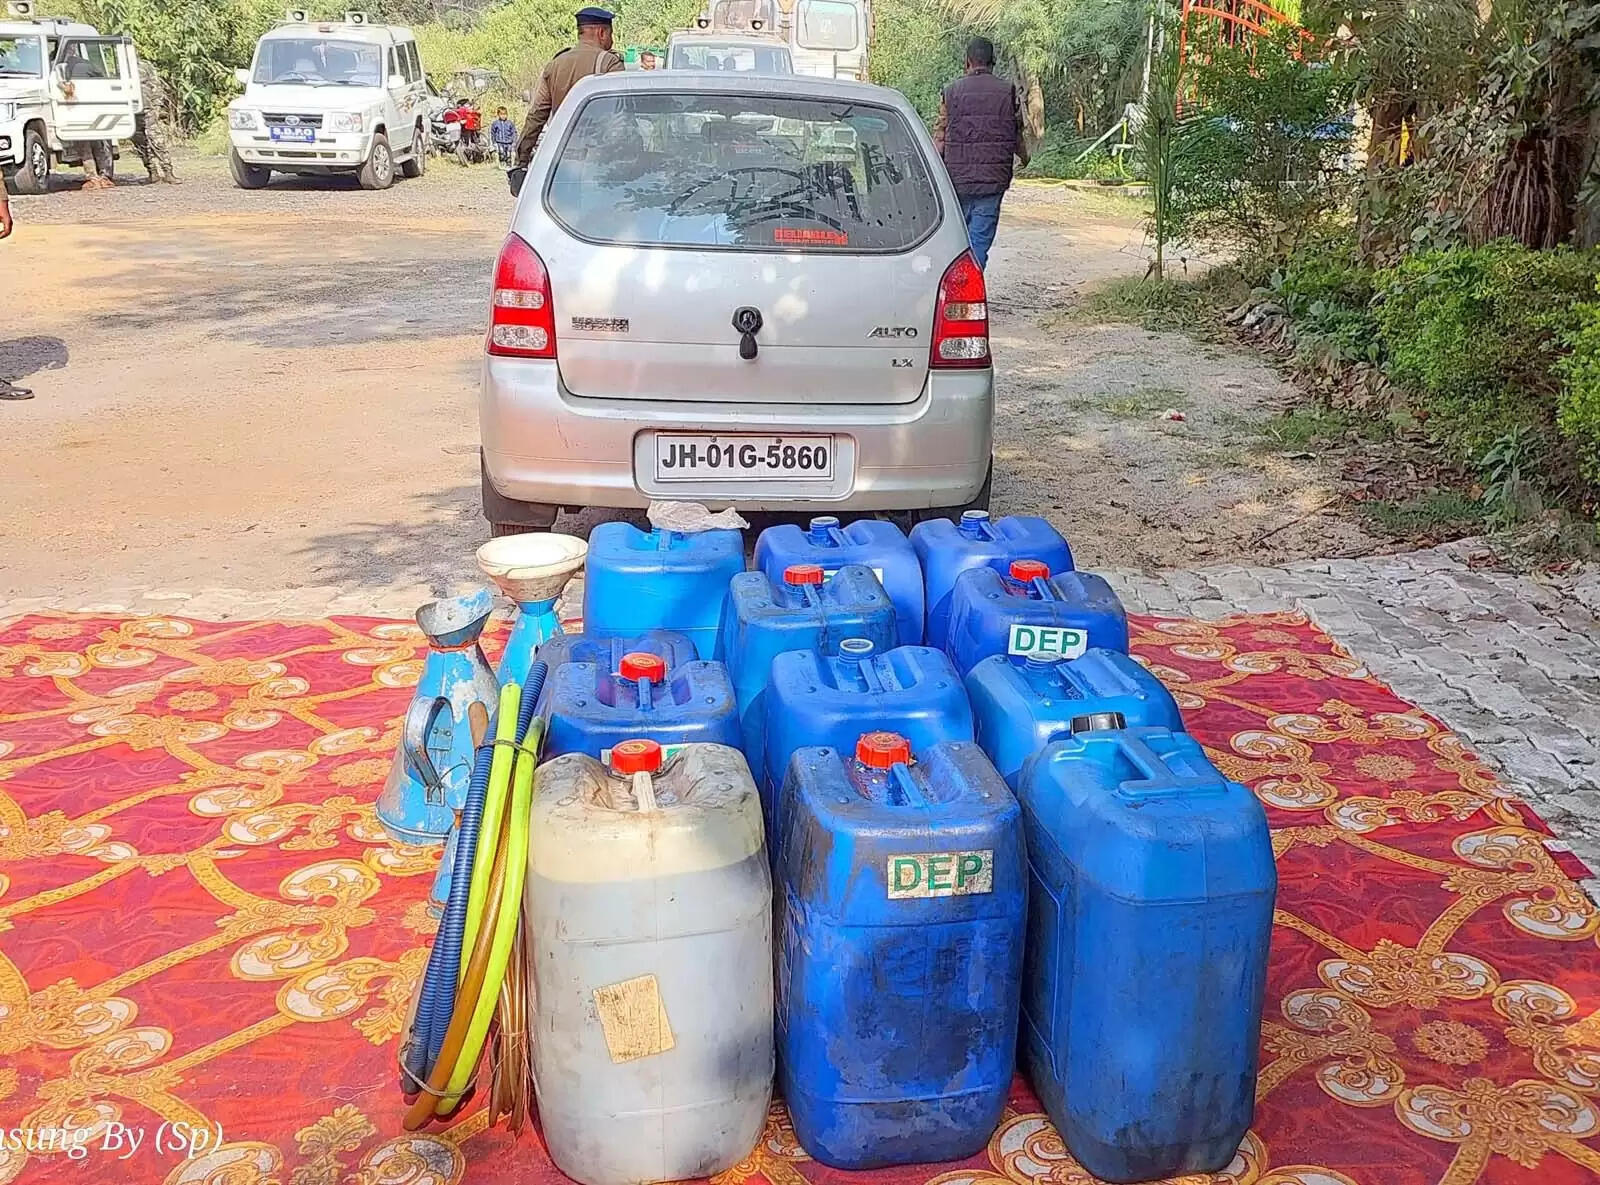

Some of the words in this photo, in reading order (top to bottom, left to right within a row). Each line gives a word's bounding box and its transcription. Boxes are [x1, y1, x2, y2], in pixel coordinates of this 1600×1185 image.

[866, 326, 918, 338] ALTO
[891, 358, 914, 368] LX
[662, 443, 828, 470] JH-01G-5860
[1015, 627, 1081, 654] DEP
[893, 854, 983, 892] DEP
